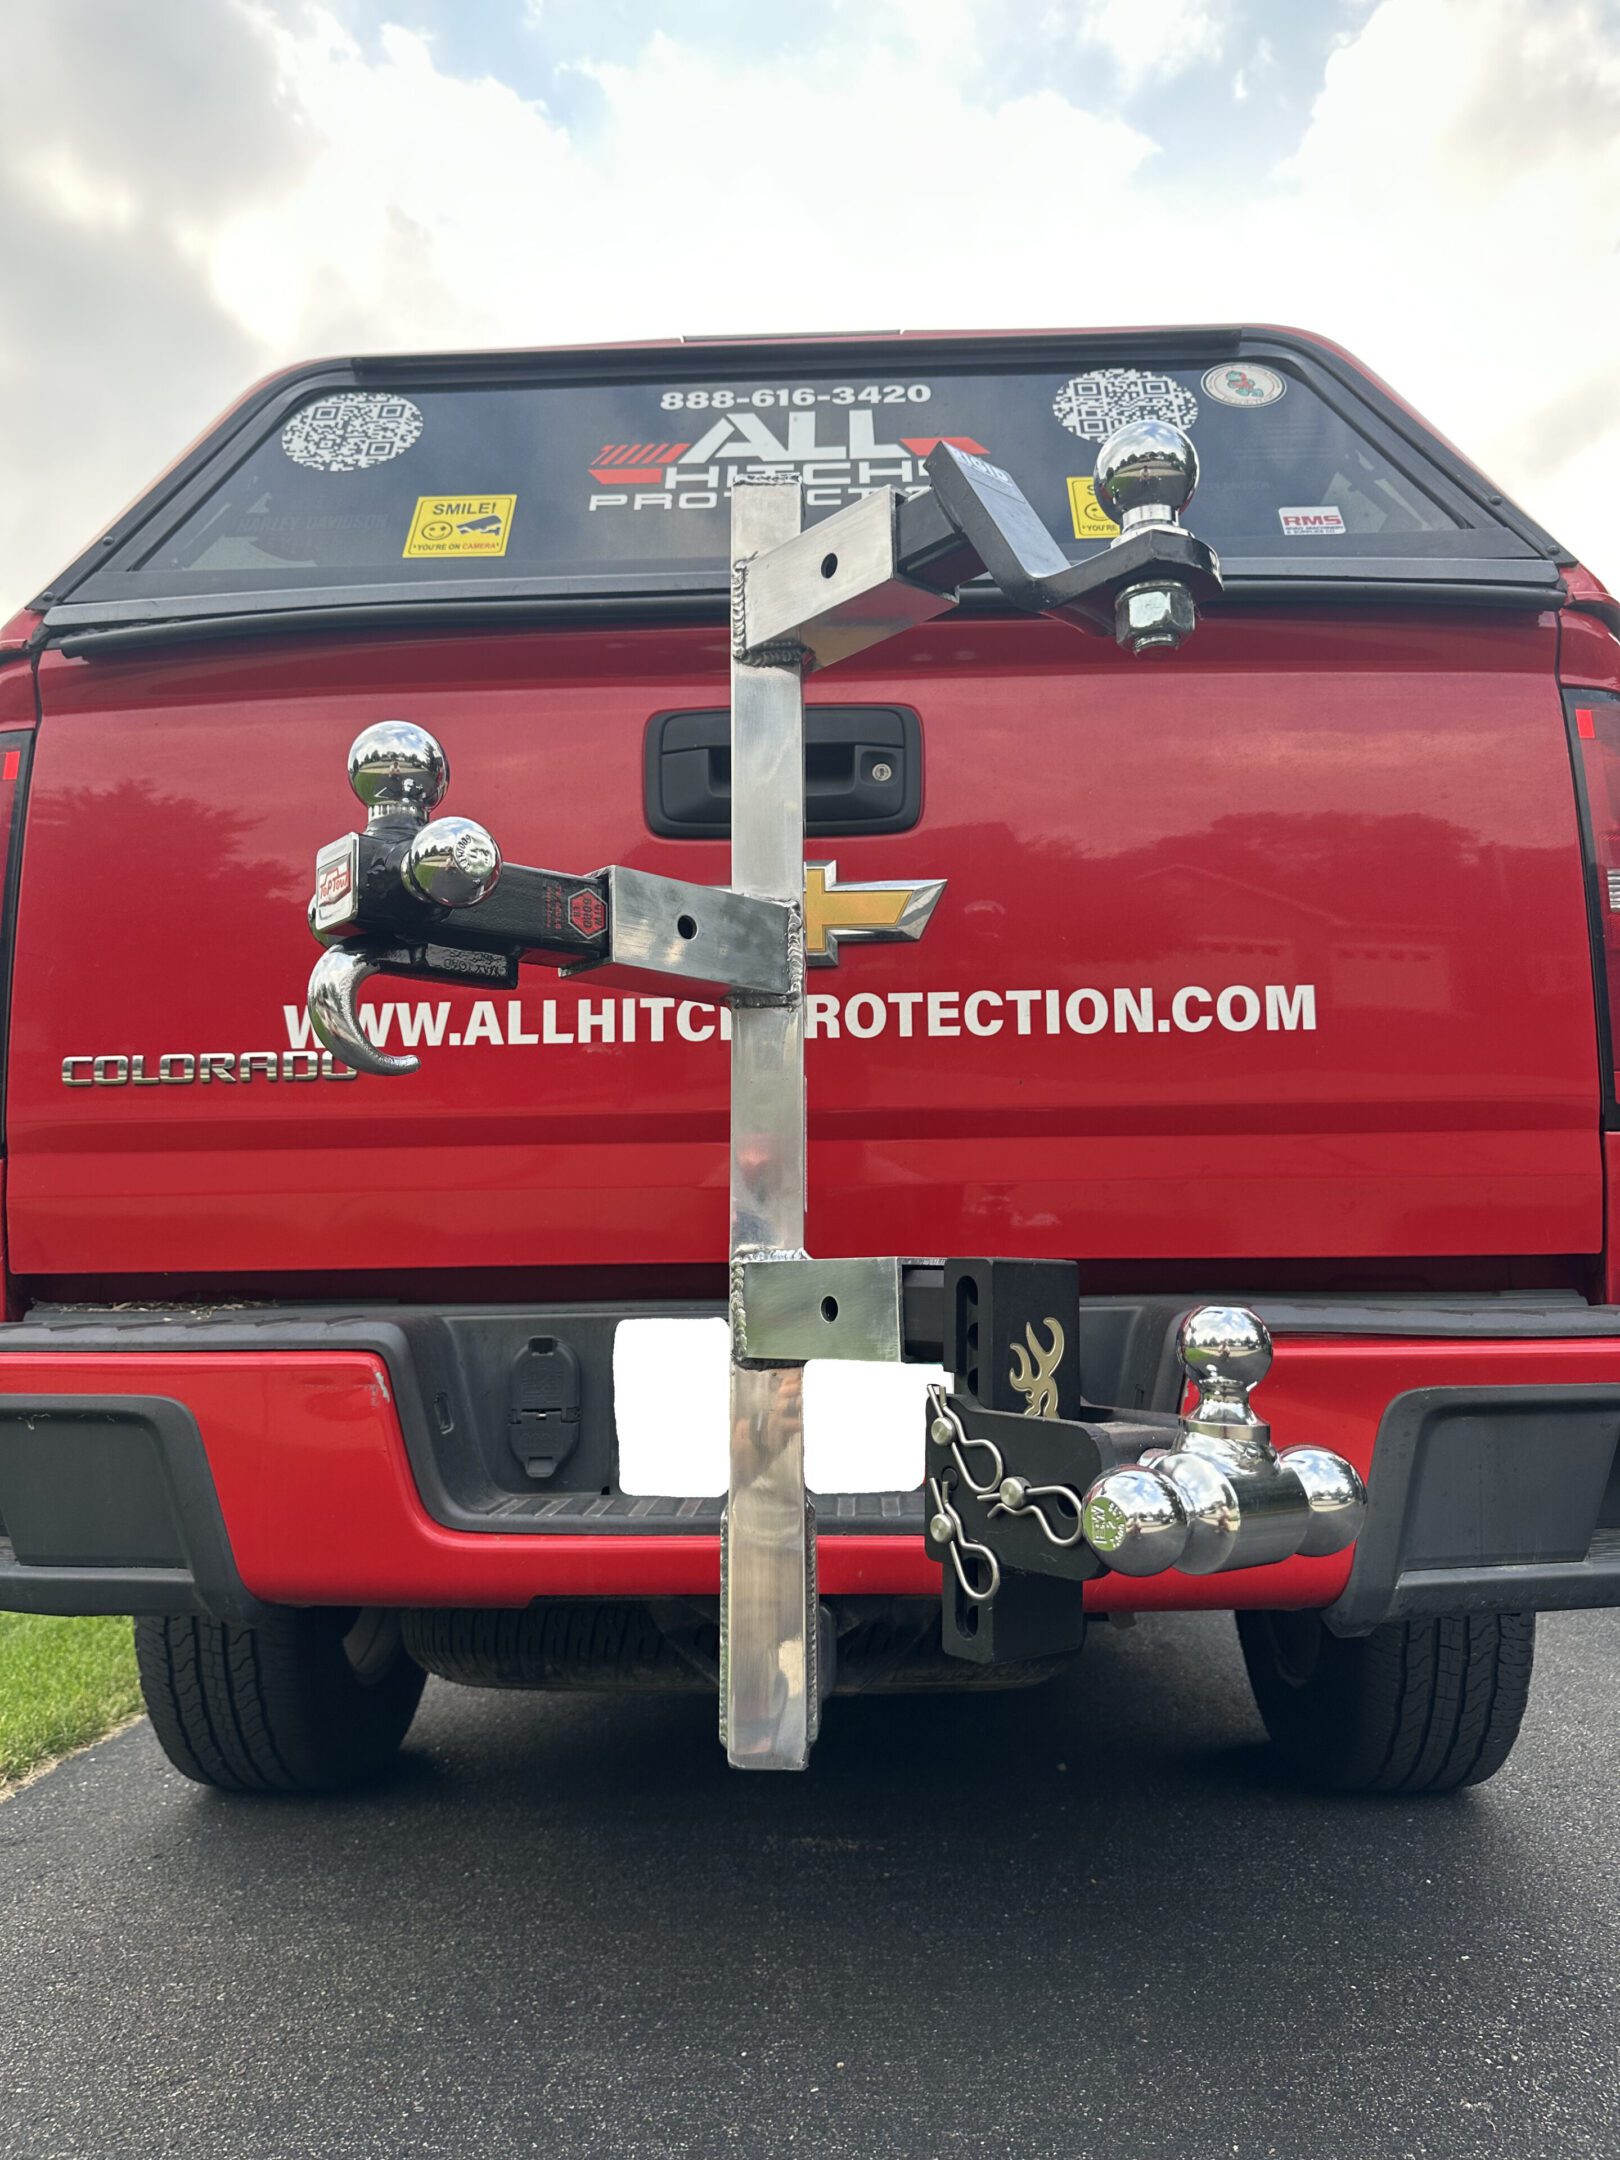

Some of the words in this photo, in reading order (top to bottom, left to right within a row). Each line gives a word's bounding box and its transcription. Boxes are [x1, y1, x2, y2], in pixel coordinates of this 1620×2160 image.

[660, 384, 932, 411] 888-616-3420
[678, 409, 911, 464] ALL
[433, 502, 497, 516] SMILE!
[1283, 516, 1342, 526] RMS
[417, 543, 447, 551] YOU'RE
[462, 542, 496, 550] CAMERA
